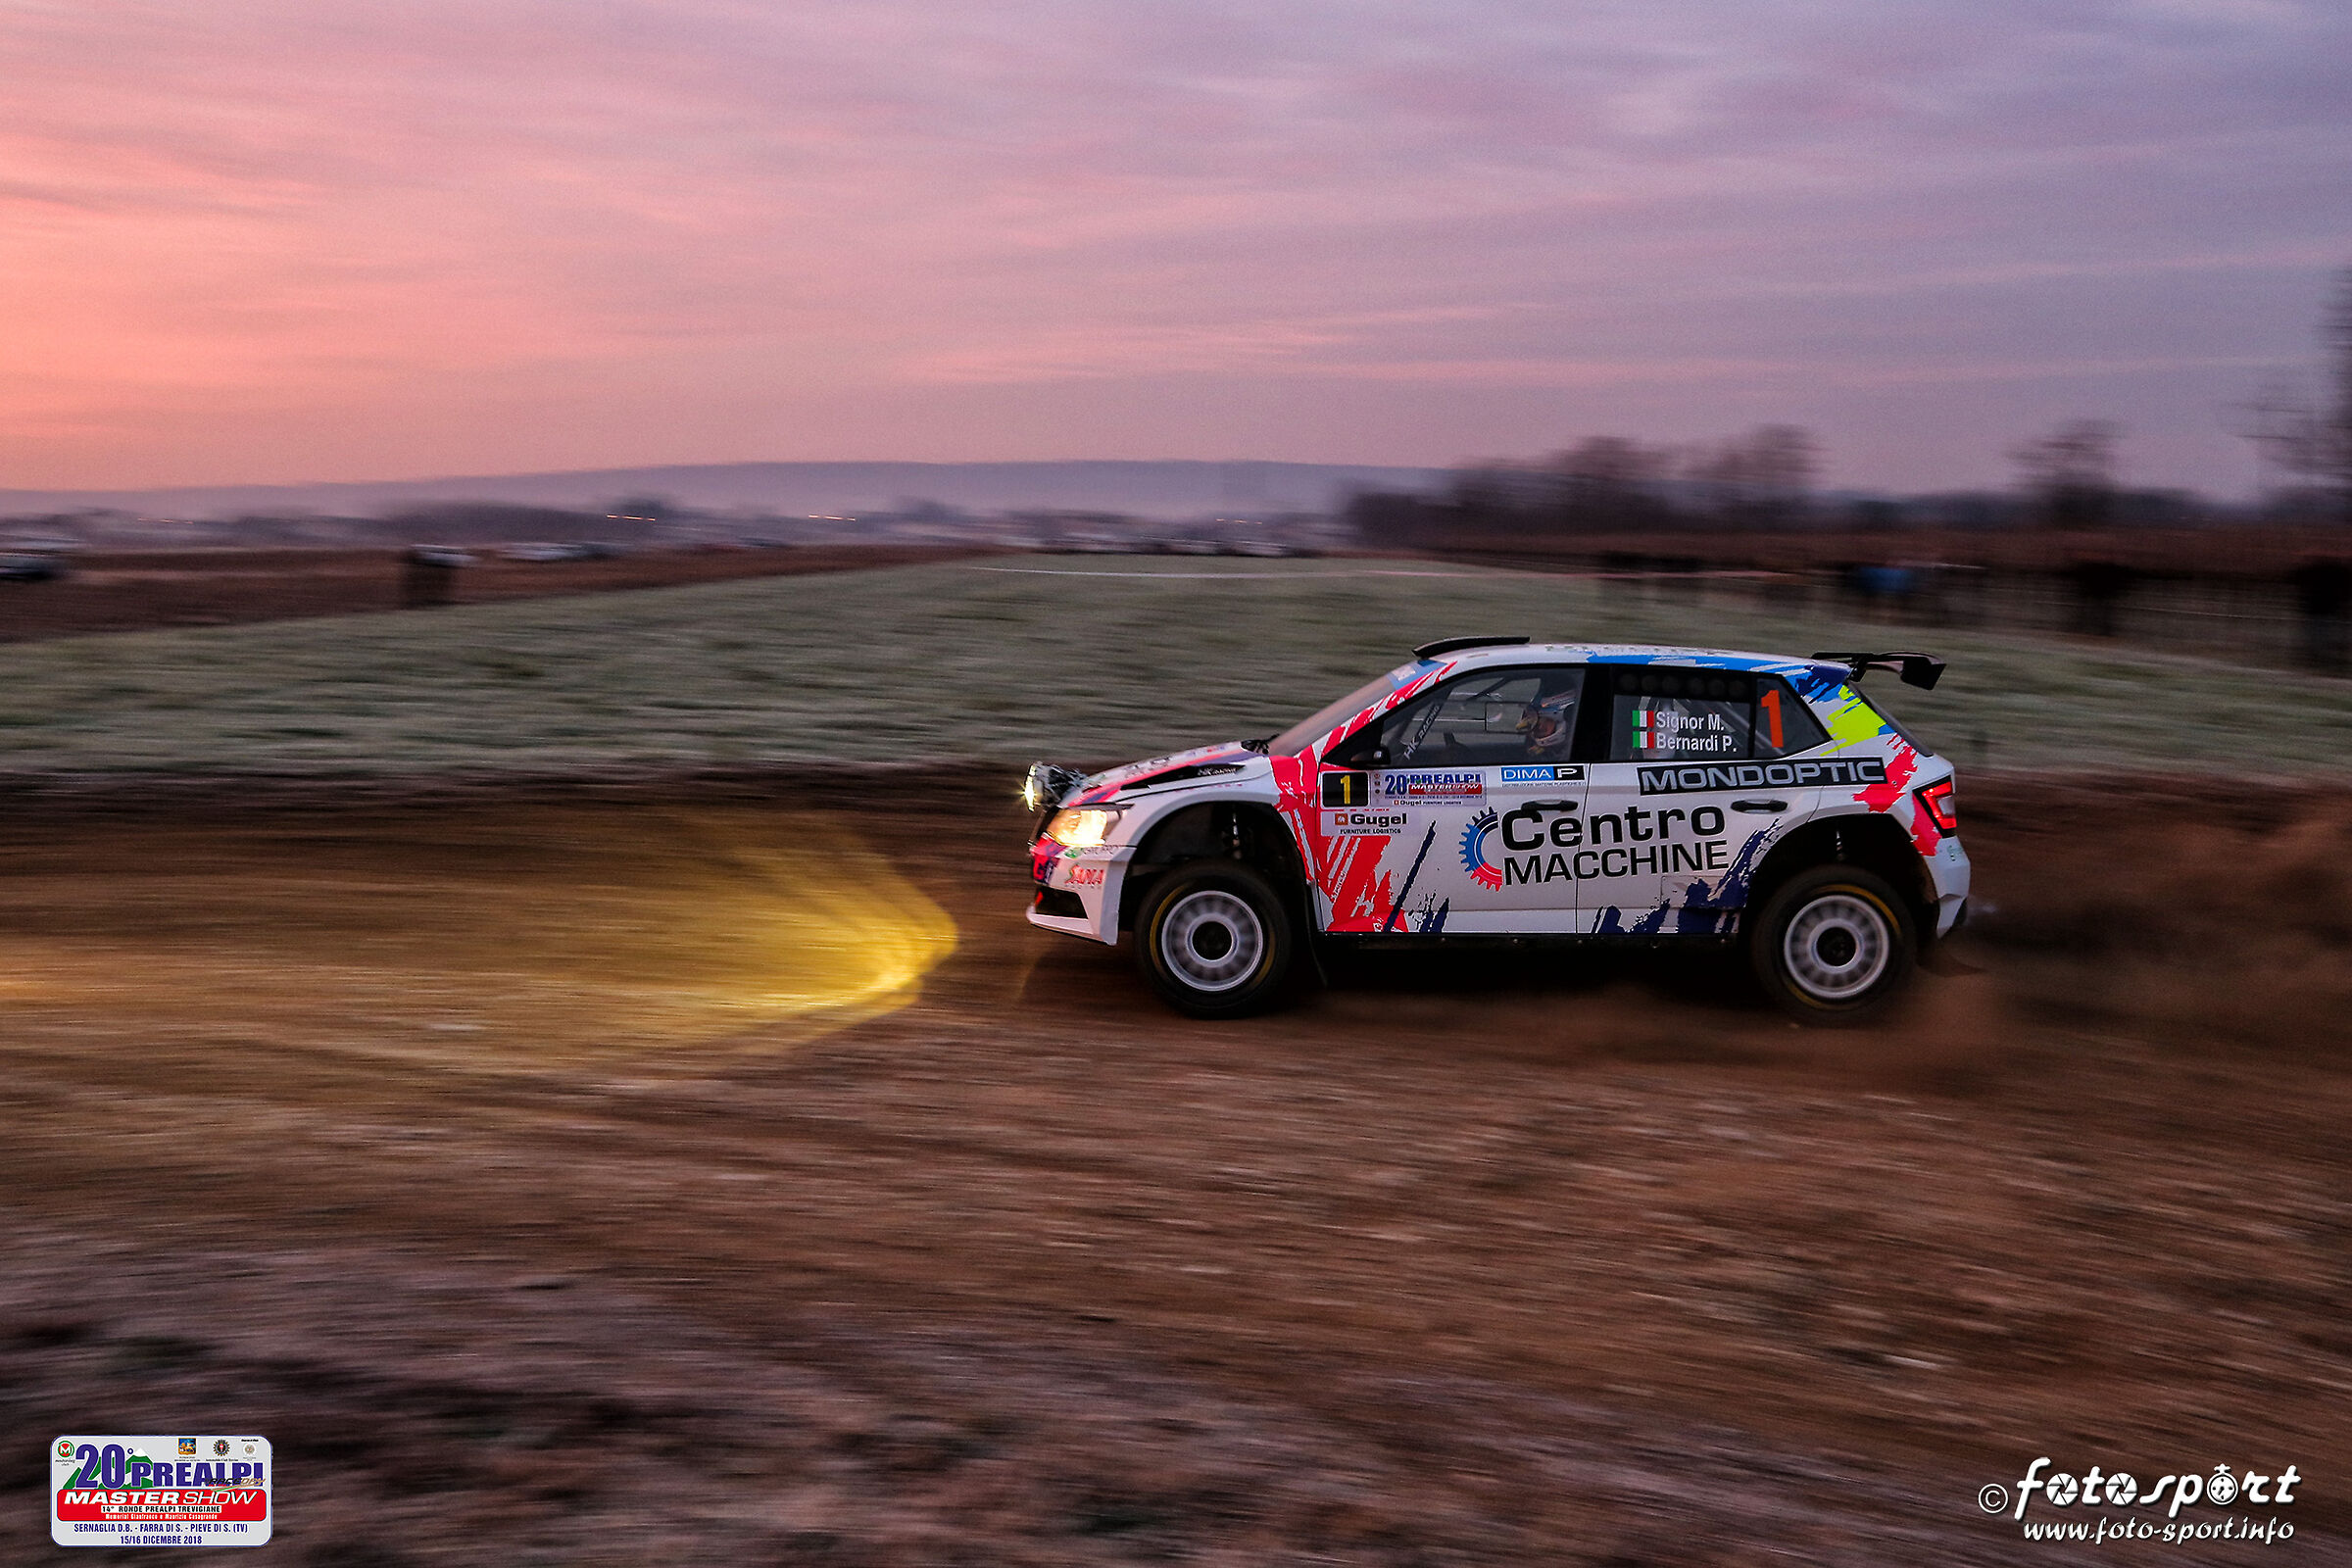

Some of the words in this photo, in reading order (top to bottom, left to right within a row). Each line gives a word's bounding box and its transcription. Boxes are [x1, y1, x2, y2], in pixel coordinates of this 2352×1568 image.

[1656, 710, 1704, 732] Signor
[1708, 713, 1725, 730] M.
[1761, 689, 1784, 748] 1
[1656, 732, 1718, 751] Bernardi
[1722, 735, 1738, 752] P.
[1409, 773, 1482, 784] PREALPI
[1503, 768, 1551, 780] DIMA
[1556, 767, 1578, 778] P
[1642, 761, 1886, 792] MONDOPTIC
[1340, 775, 1351, 805] 1
[1350, 812, 1407, 827] Gugel
[1501, 806, 1725, 851] Centro
[1504, 839, 1729, 886] MACCHINE
